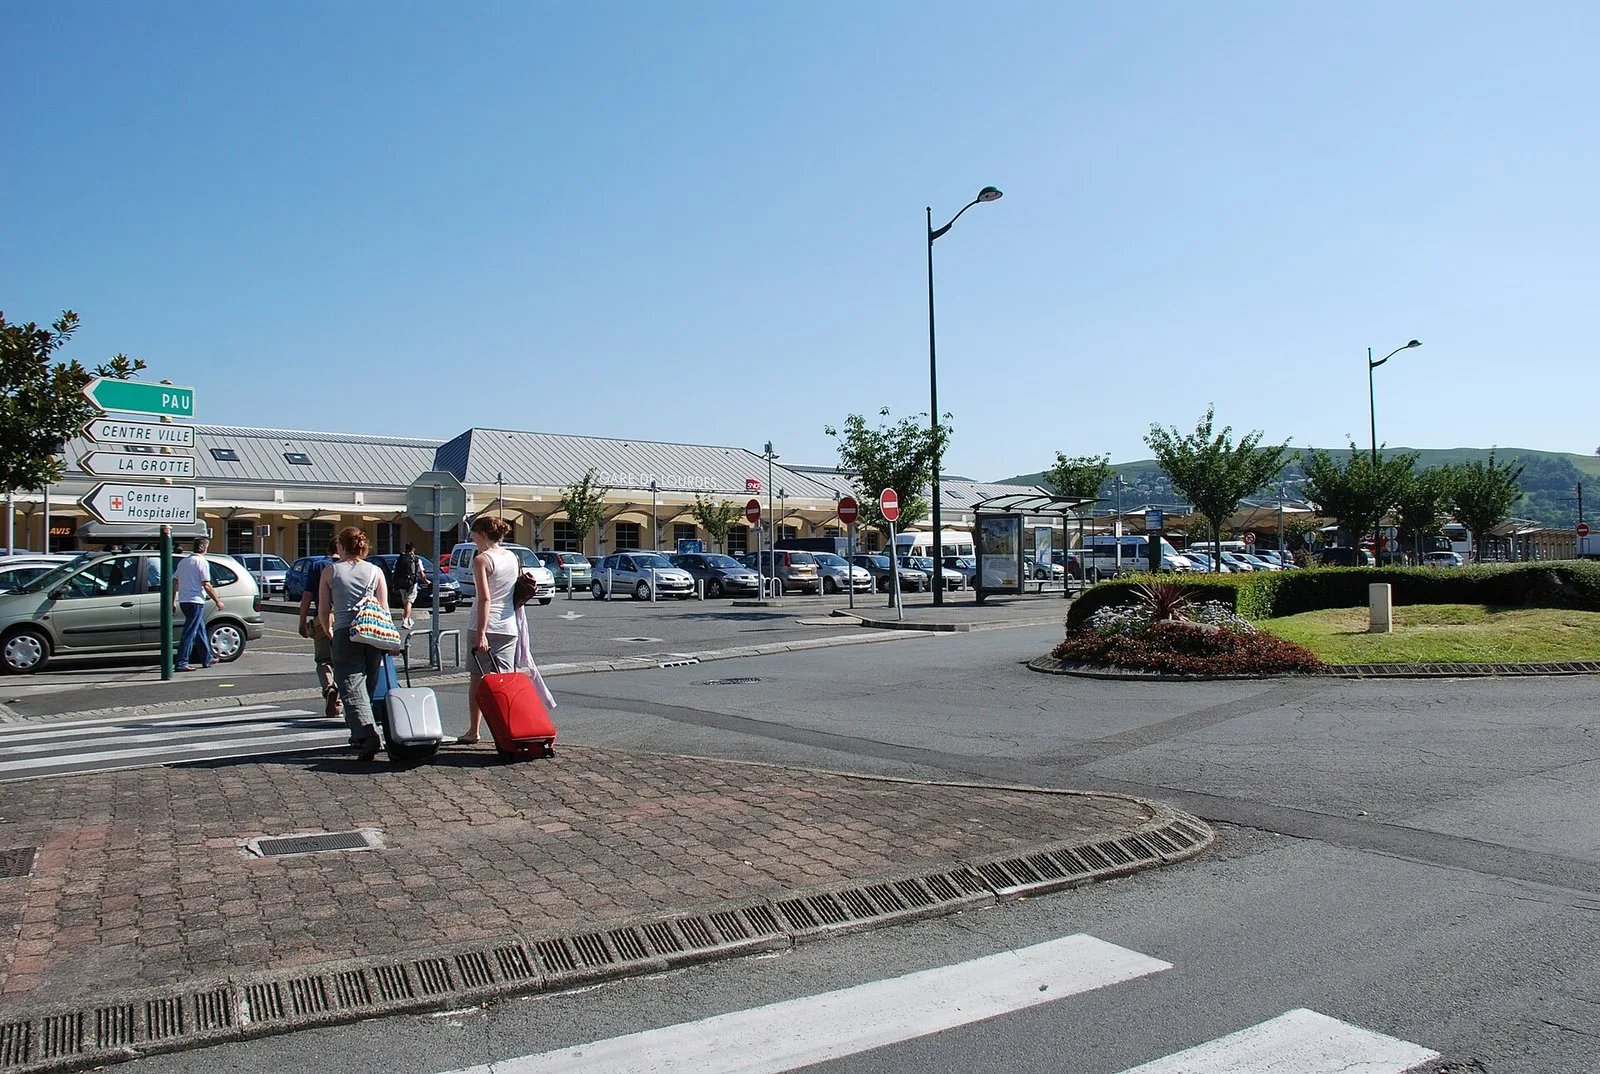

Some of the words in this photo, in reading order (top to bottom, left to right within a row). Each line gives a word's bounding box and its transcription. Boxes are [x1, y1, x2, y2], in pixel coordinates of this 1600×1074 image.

[162, 393, 190, 410] PAU
[102, 425, 151, 440] CENTRE
[158, 428, 190, 442] VILLE
[118, 458, 134, 470] LA
[141, 460, 190, 473] GROTTE
[600, 471, 635, 485] GARE
[661, 474, 717, 489] LOURDES
[127, 490, 169, 503] Centre
[127, 506, 191, 520] Hospitalier
[50, 527, 71, 535] AVIS
